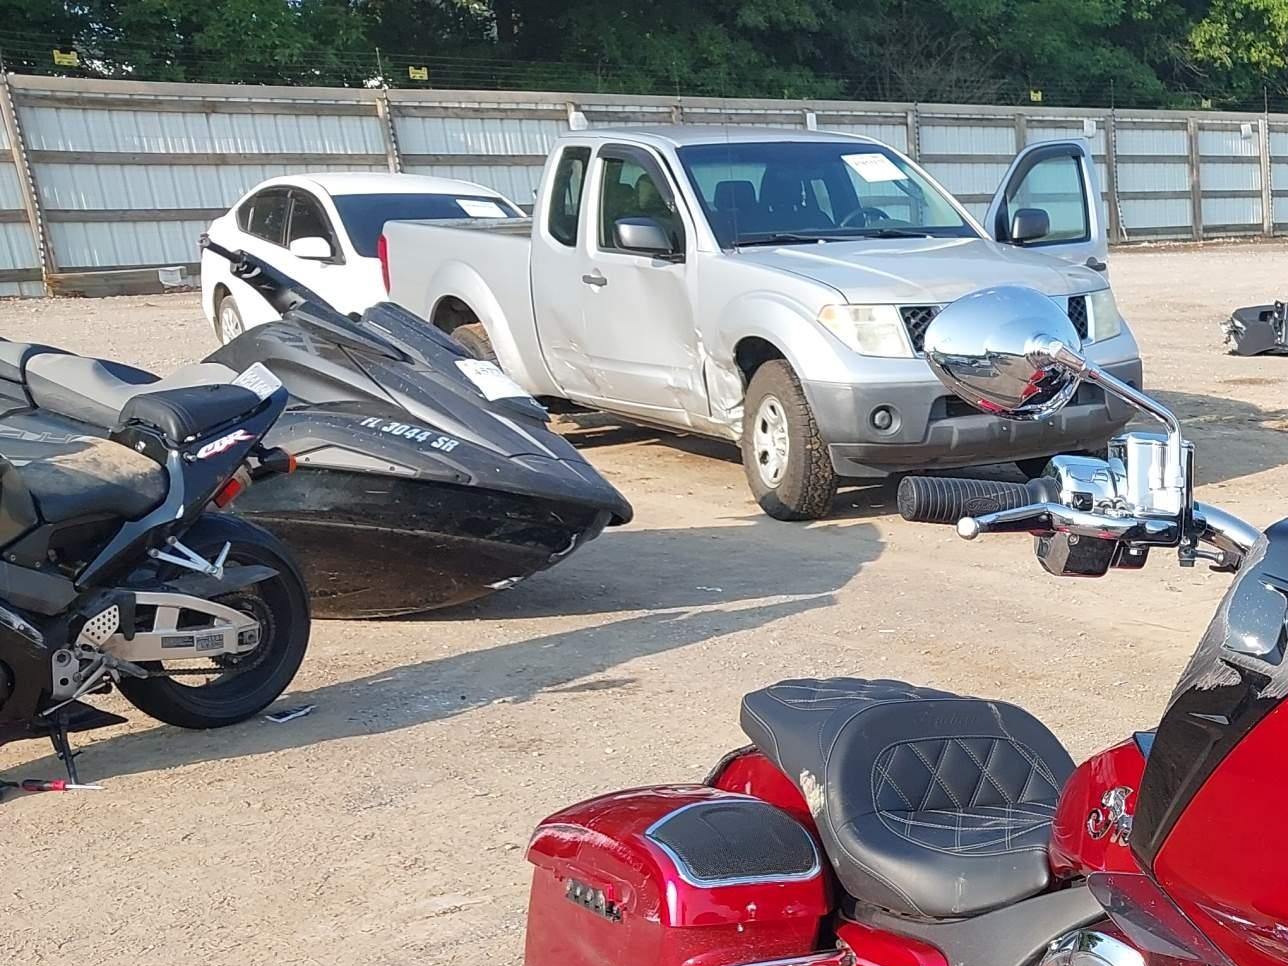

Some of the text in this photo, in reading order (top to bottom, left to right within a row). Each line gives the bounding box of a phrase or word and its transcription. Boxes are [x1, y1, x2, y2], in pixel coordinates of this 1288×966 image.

[360, 416, 460, 453] FL 3044 SR
